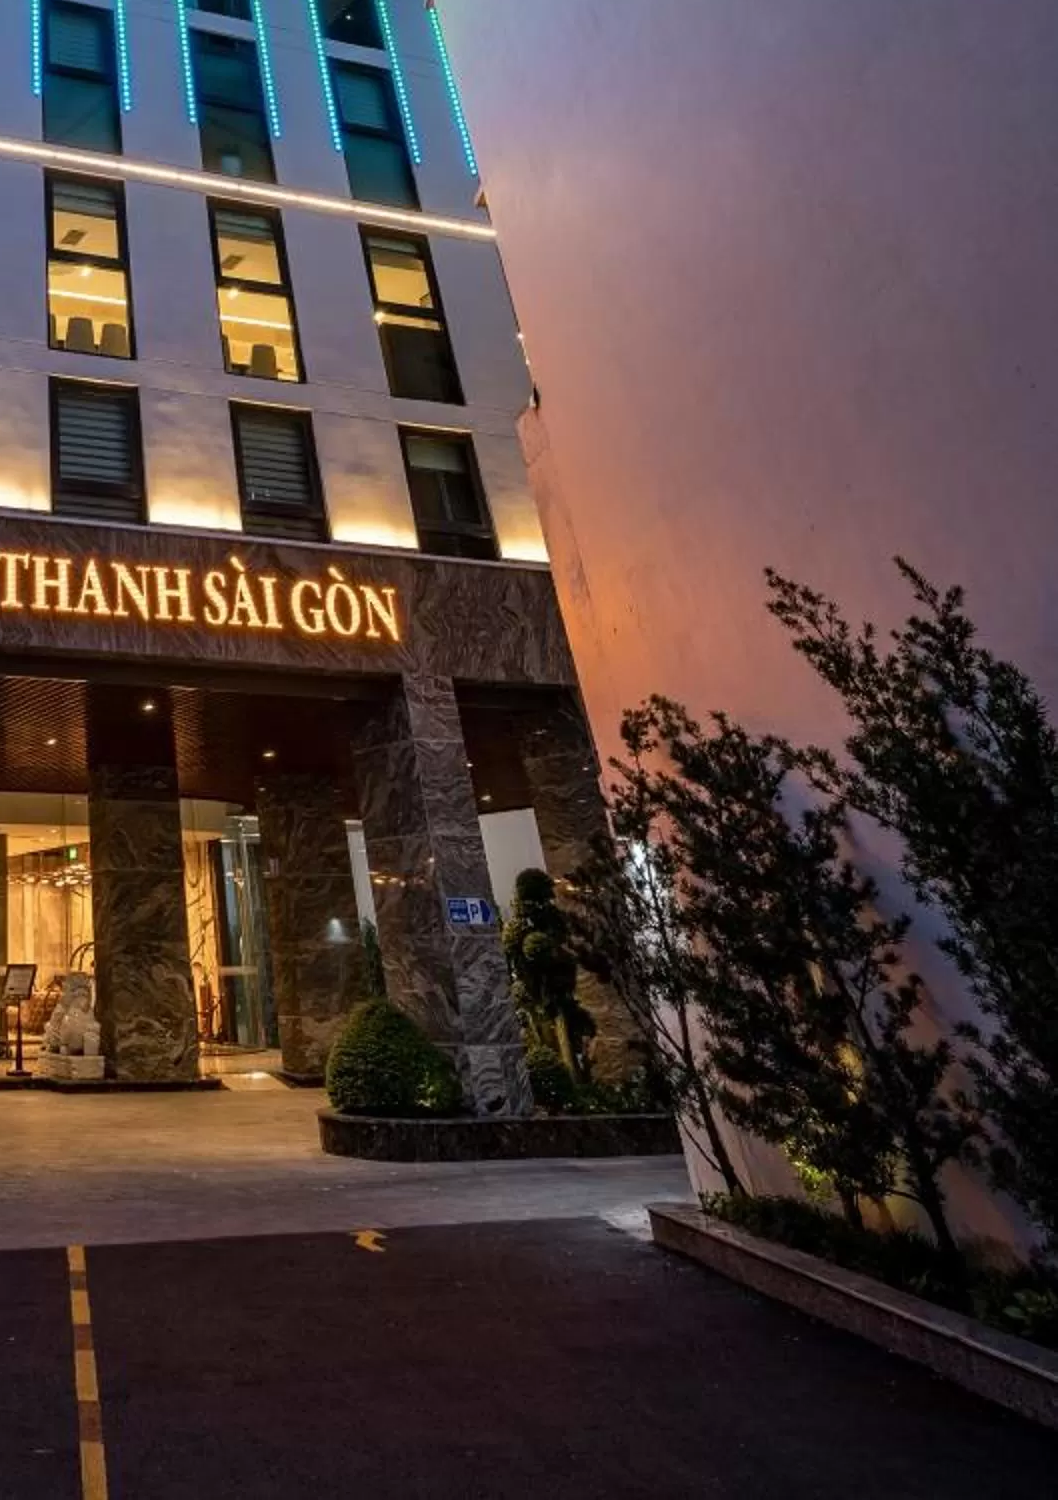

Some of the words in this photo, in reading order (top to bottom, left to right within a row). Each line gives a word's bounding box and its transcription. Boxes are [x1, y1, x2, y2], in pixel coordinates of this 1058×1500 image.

[202, 555, 283, 630] SÀI
[290, 566, 402, 641] GÒN
[470, 903, 480, 918] P
